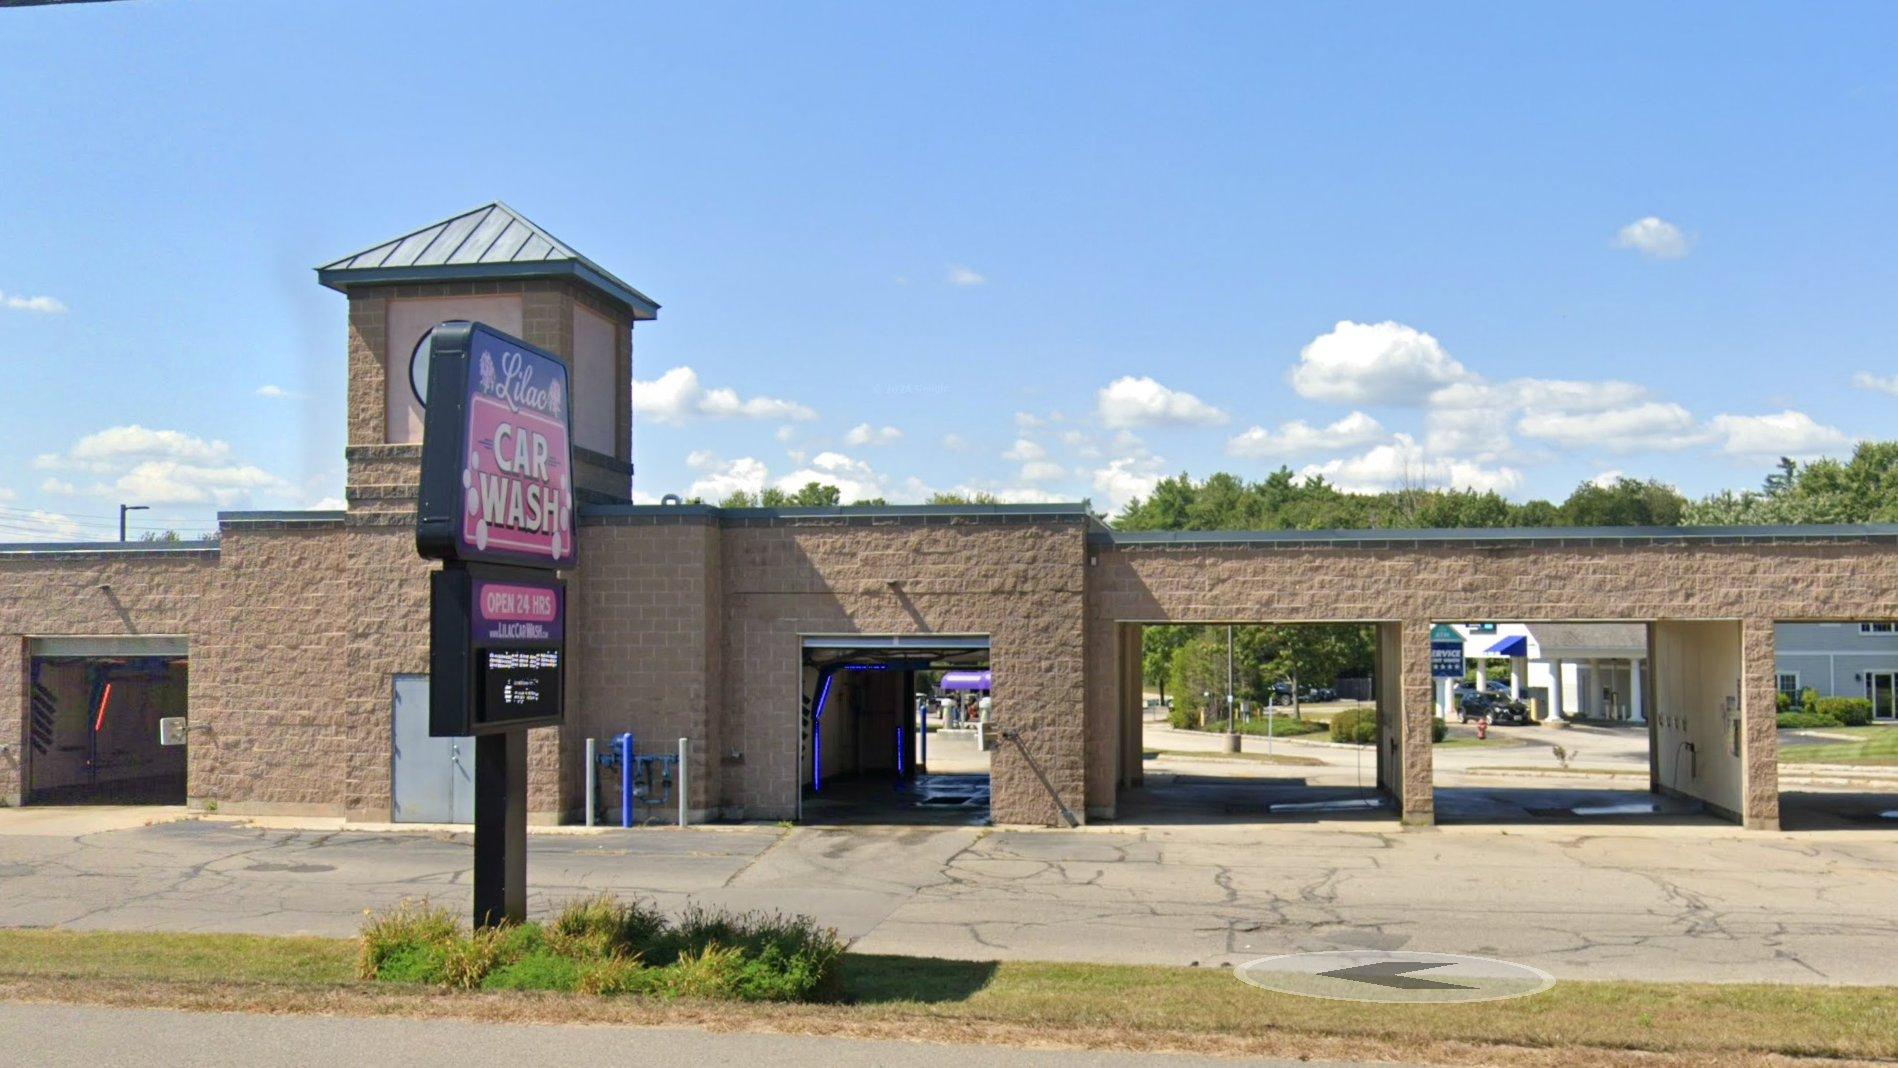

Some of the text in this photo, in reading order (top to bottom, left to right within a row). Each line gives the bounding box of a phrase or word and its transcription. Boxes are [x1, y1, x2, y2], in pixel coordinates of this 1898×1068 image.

[495, 352, 547, 412] Lilac
[494, 422, 549, 482] CAR
[479, 472, 560, 535] WASH
[487, 592, 551, 616] OPEN 24 HRS
[1432, 649, 1461, 658] ERVICE
